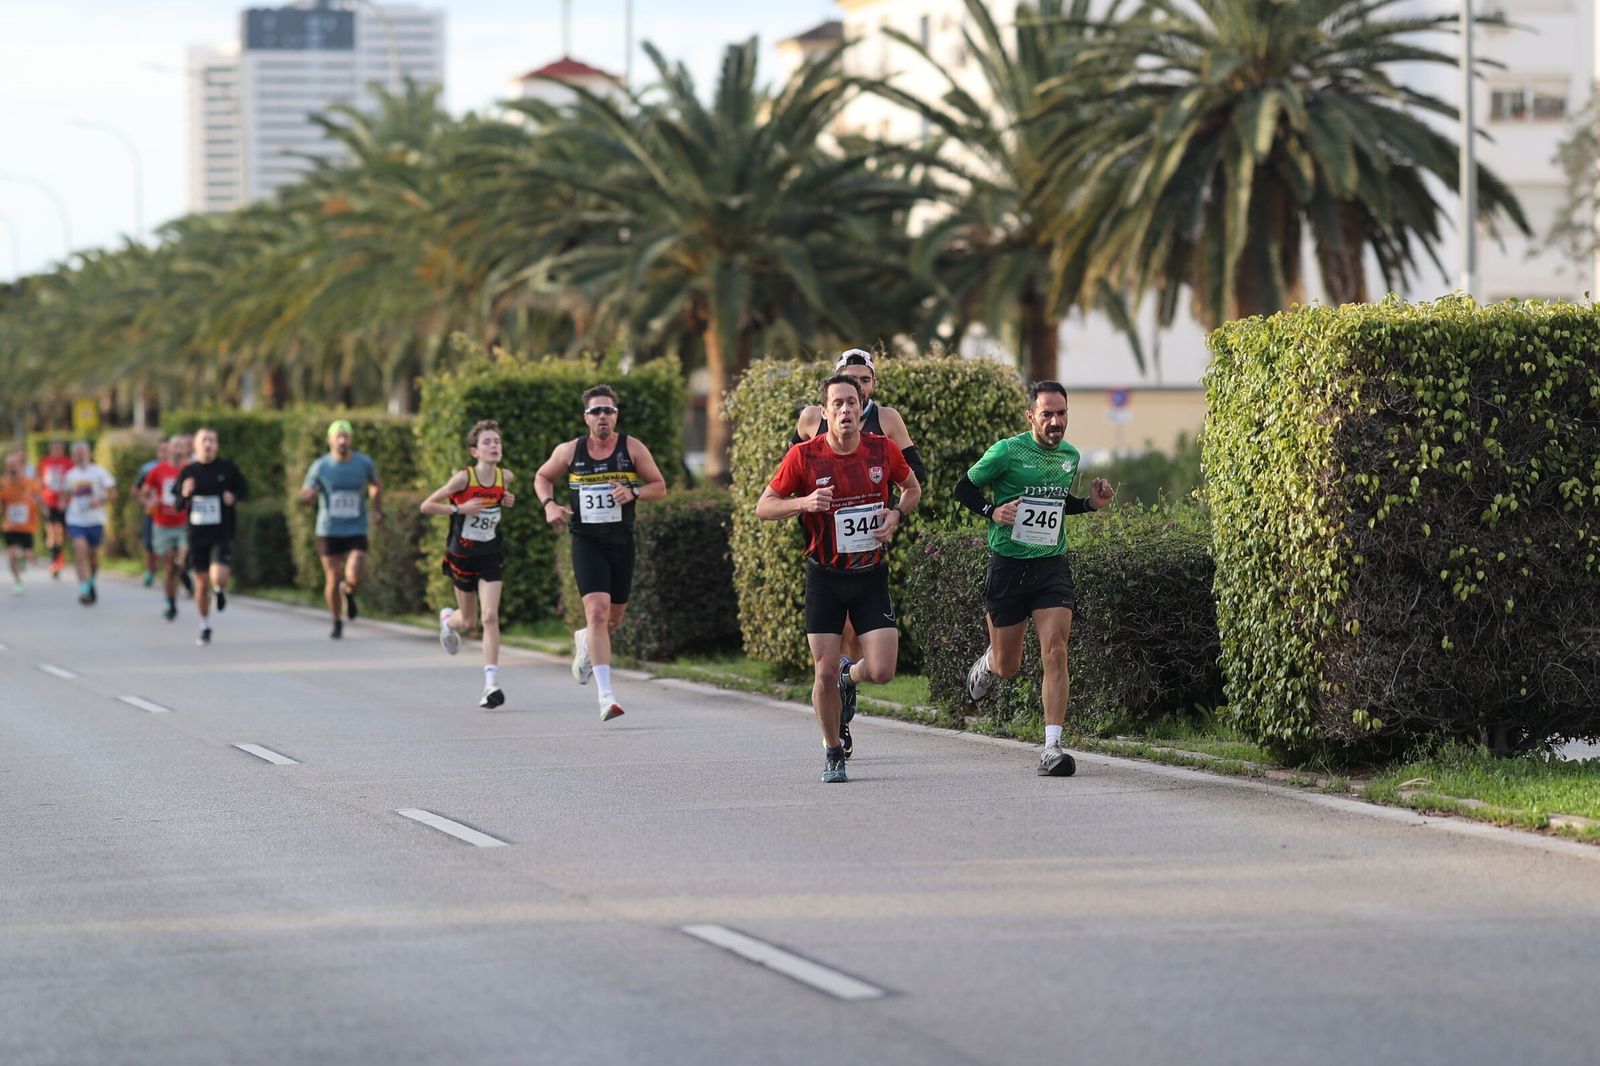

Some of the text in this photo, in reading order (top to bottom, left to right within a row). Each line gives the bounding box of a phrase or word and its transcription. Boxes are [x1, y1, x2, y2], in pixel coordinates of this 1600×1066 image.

[1023, 483, 1069, 498] mijas
[585, 494, 616, 509] 313
[843, 515, 880, 537] 344
[1022, 509, 1058, 529] 246
